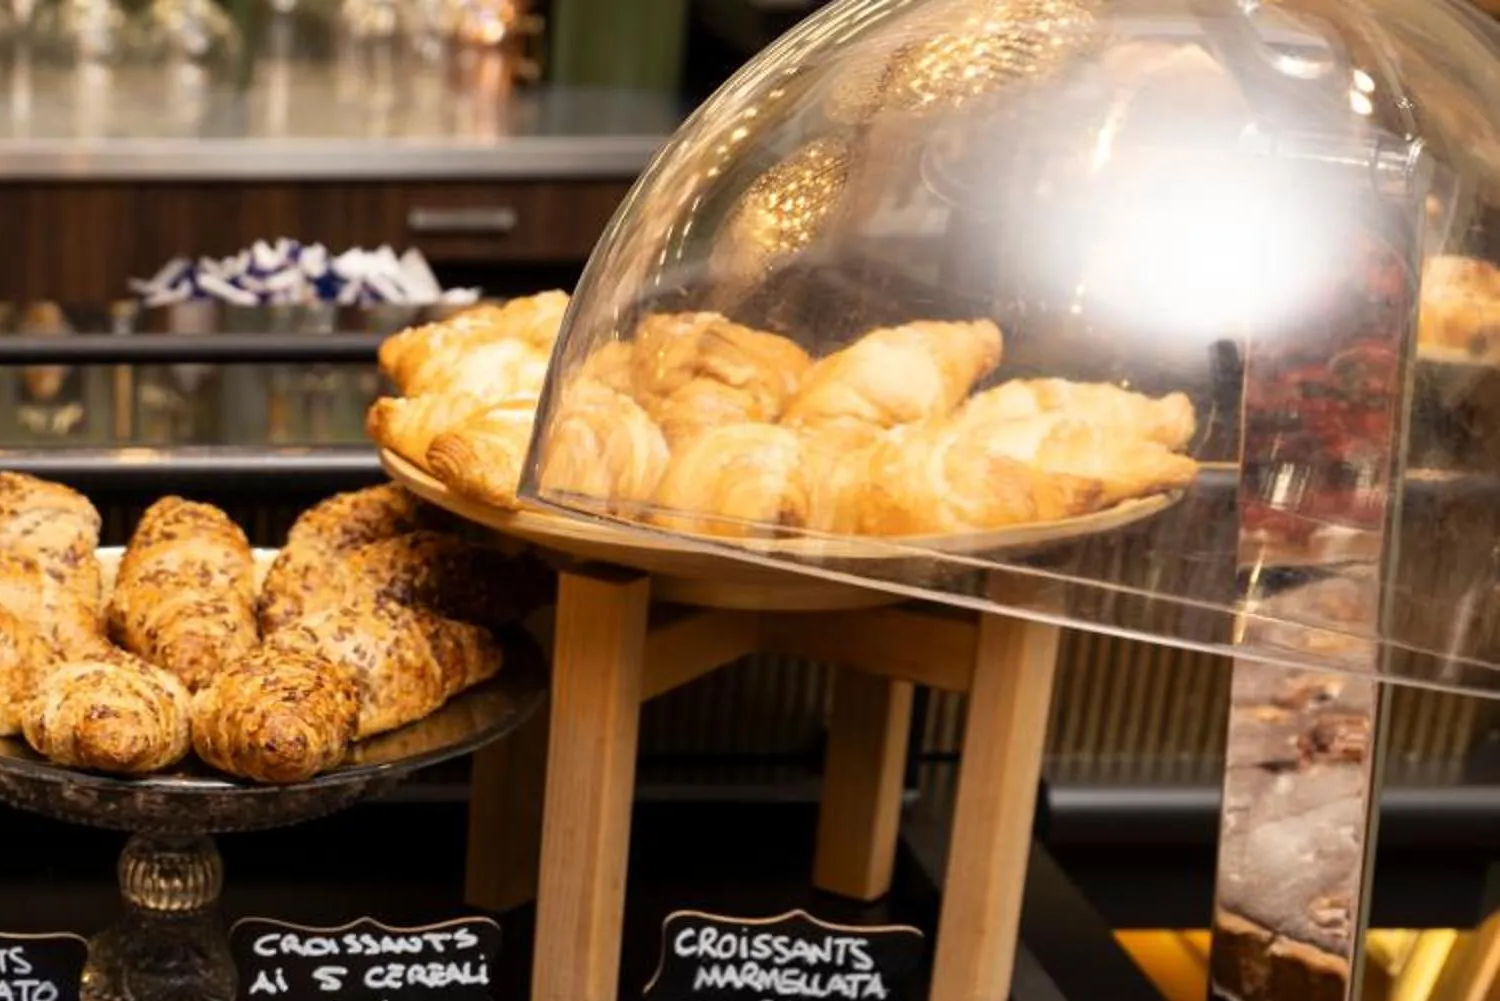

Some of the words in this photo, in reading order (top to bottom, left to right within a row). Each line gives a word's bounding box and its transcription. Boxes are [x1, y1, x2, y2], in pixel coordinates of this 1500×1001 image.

[253, 928, 479, 956] CROISSANTS
[674, 927, 874, 971] CROISSANTS
[693, 961, 888, 1000] MARMELLATA
